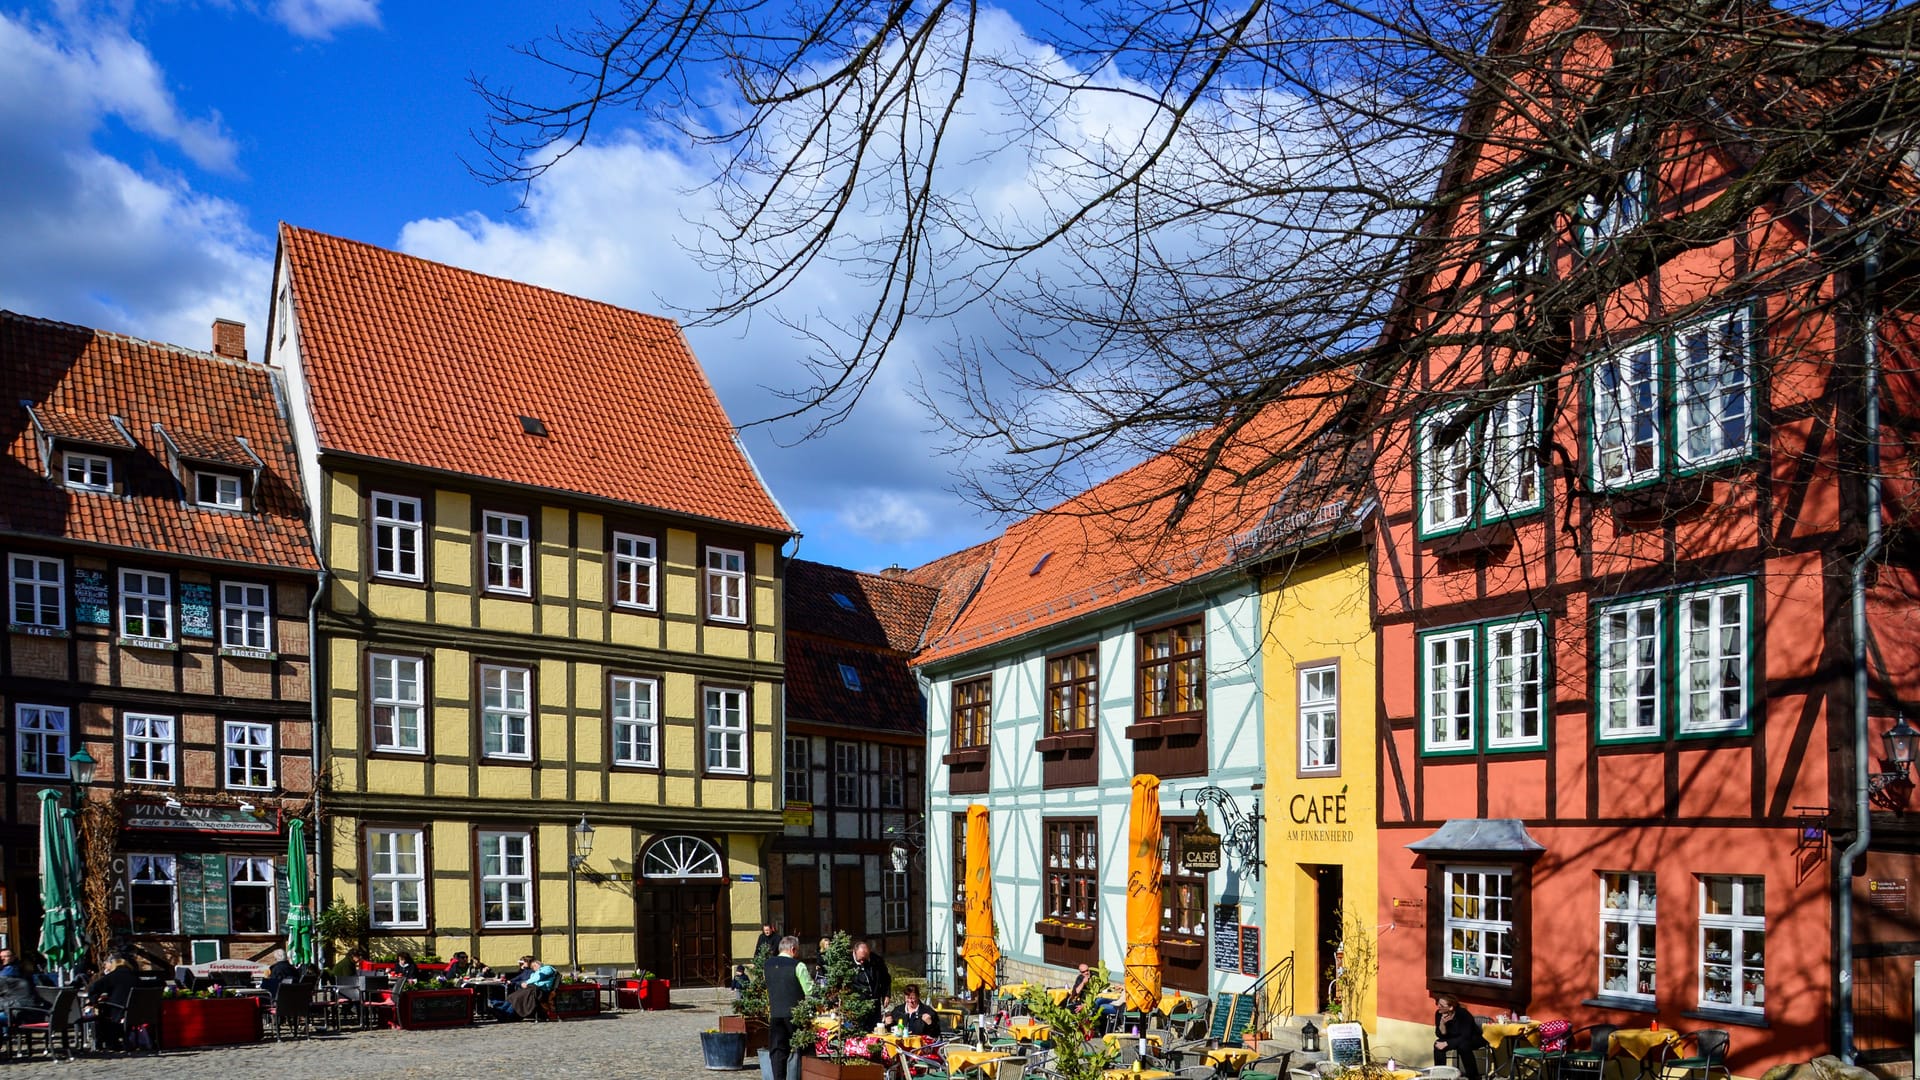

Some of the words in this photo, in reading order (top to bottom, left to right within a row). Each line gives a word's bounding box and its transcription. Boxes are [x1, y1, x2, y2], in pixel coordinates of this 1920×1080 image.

[132, 639, 164, 649] KUCHEN
[1289, 784, 1348, 824] CAFÉ
[135, 804, 213, 818] VINCENT
[1286, 830, 1299, 841] AM
[1300, 830, 1354, 842] FINKENHERD
[1186, 850, 1217, 863] CAFÉ
[112, 858, 125, 910] CAF
